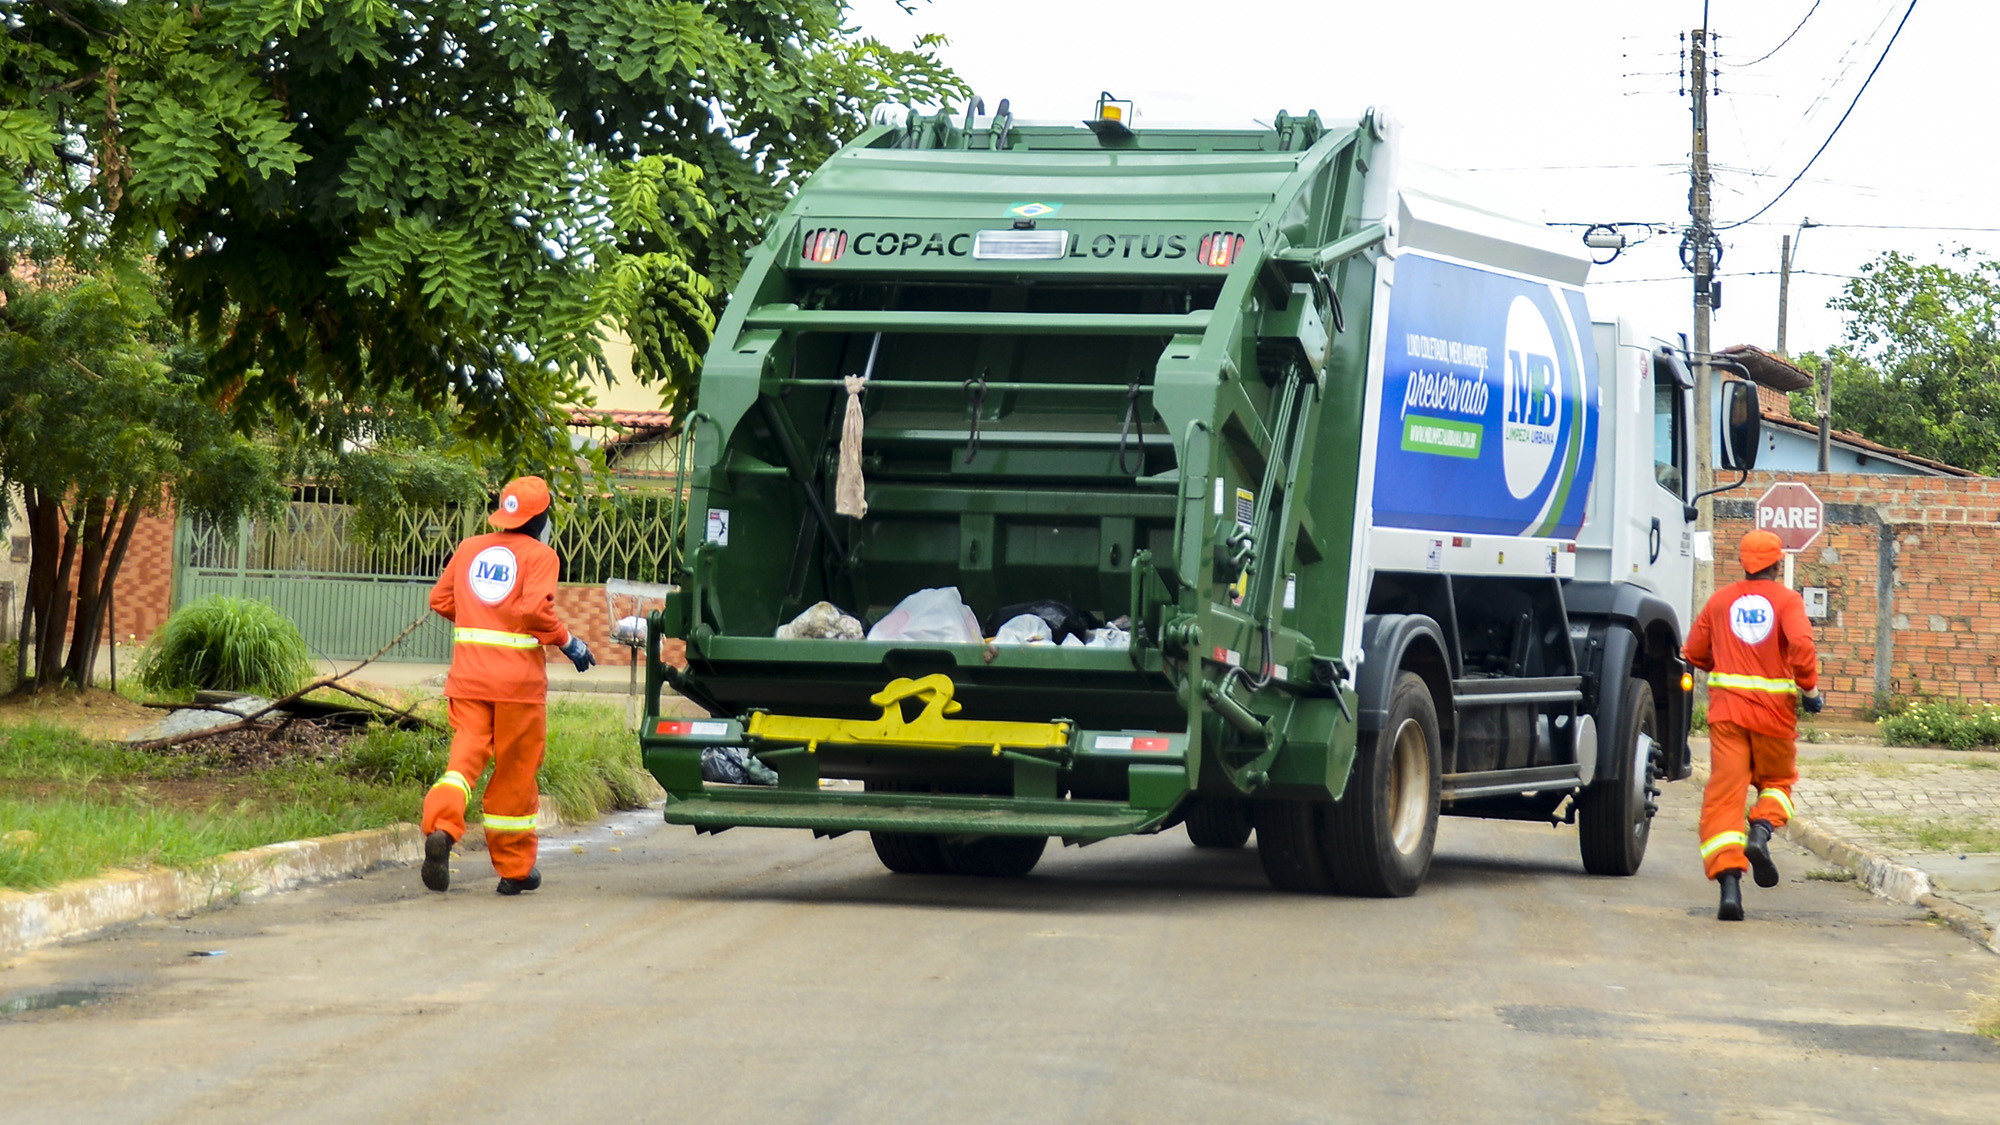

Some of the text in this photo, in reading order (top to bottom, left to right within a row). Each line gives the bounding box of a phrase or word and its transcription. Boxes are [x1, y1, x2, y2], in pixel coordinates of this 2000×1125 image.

[852, 232, 970, 257] COPAC
[1069, 232, 1187, 259] LOTUS
[1401, 367, 1488, 420] preservado
[1508, 349, 1556, 427] MB
[1506, 426, 1554, 445] LIMPEZA URBANA
[1760, 507, 1818, 529] PARE
[475, 560, 509, 582] MB
[1736, 607, 1766, 624] MB
